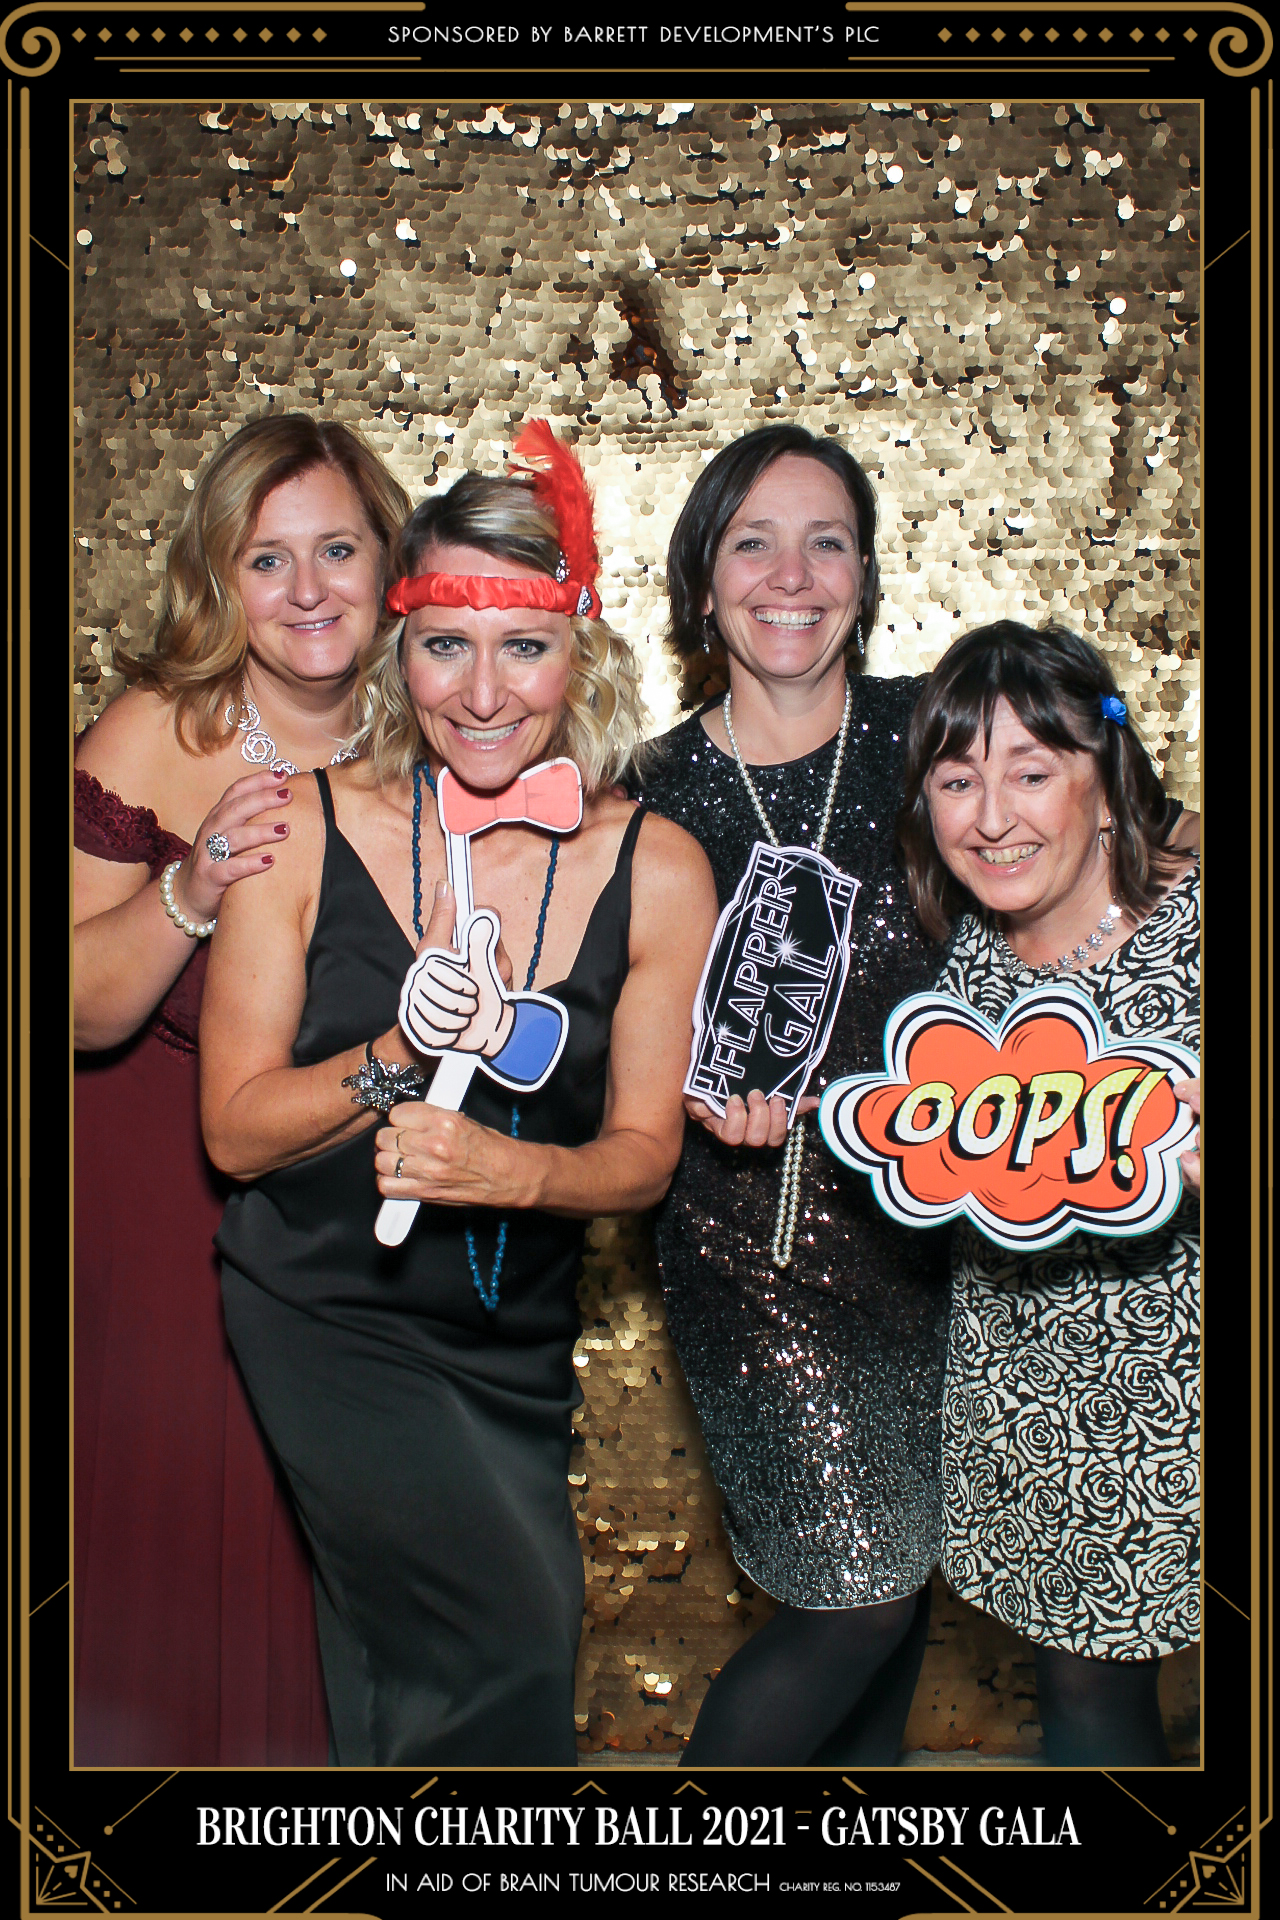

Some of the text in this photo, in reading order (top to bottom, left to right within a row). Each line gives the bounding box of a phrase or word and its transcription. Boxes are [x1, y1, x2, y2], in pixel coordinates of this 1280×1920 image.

[709, 876, 797, 1079] FLAPPER
[764, 944, 836, 1057] GAL
[884, 1067, 1173, 1191] OOPS!
